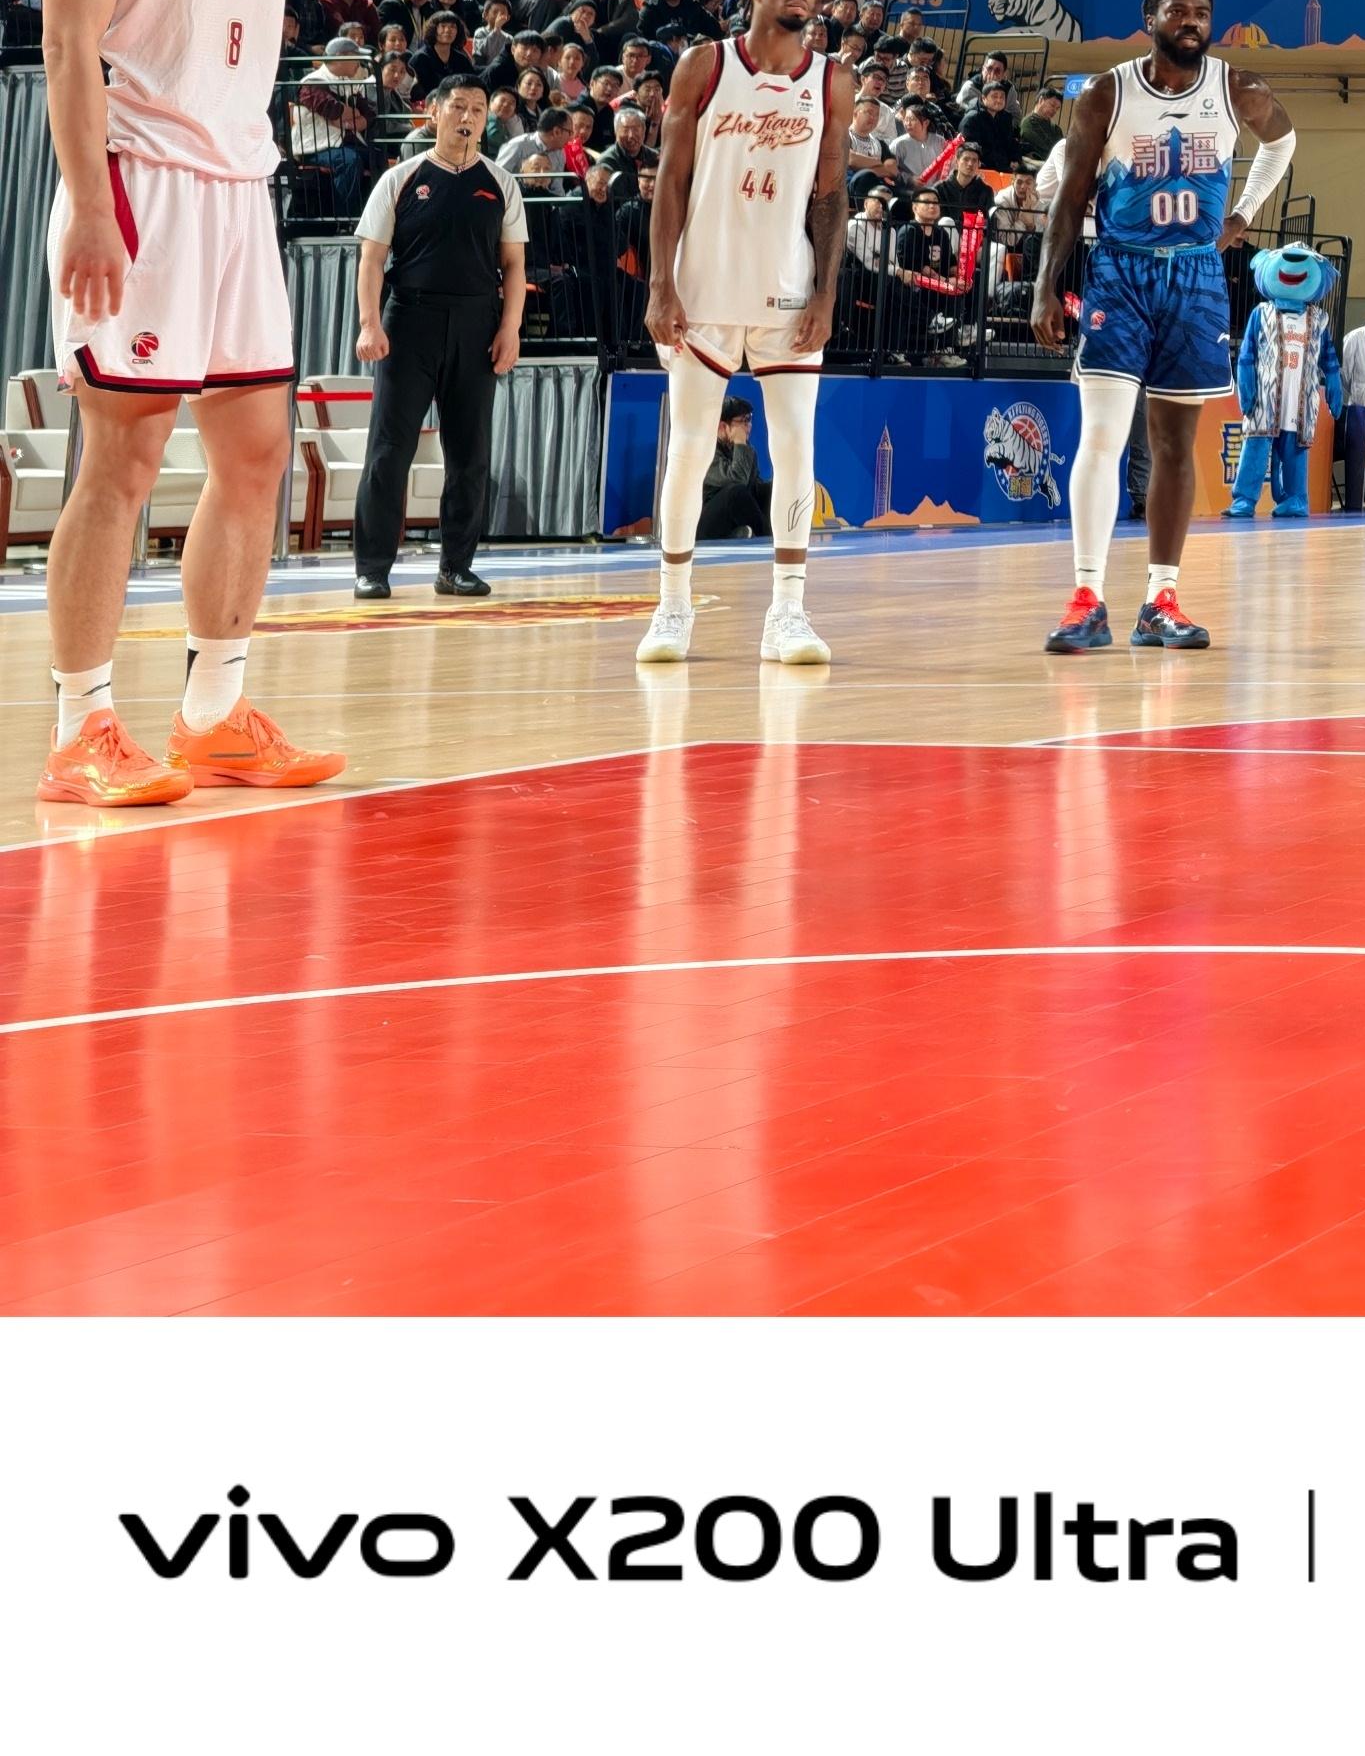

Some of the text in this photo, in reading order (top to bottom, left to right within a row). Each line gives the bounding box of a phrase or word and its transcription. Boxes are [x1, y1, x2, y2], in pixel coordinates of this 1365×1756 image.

[227, 18, 243, 67] 8
[1131, 129, 1218, 179] 新疆
[739, 167, 777, 202] 44
[1150, 190, 1200, 226] 00
